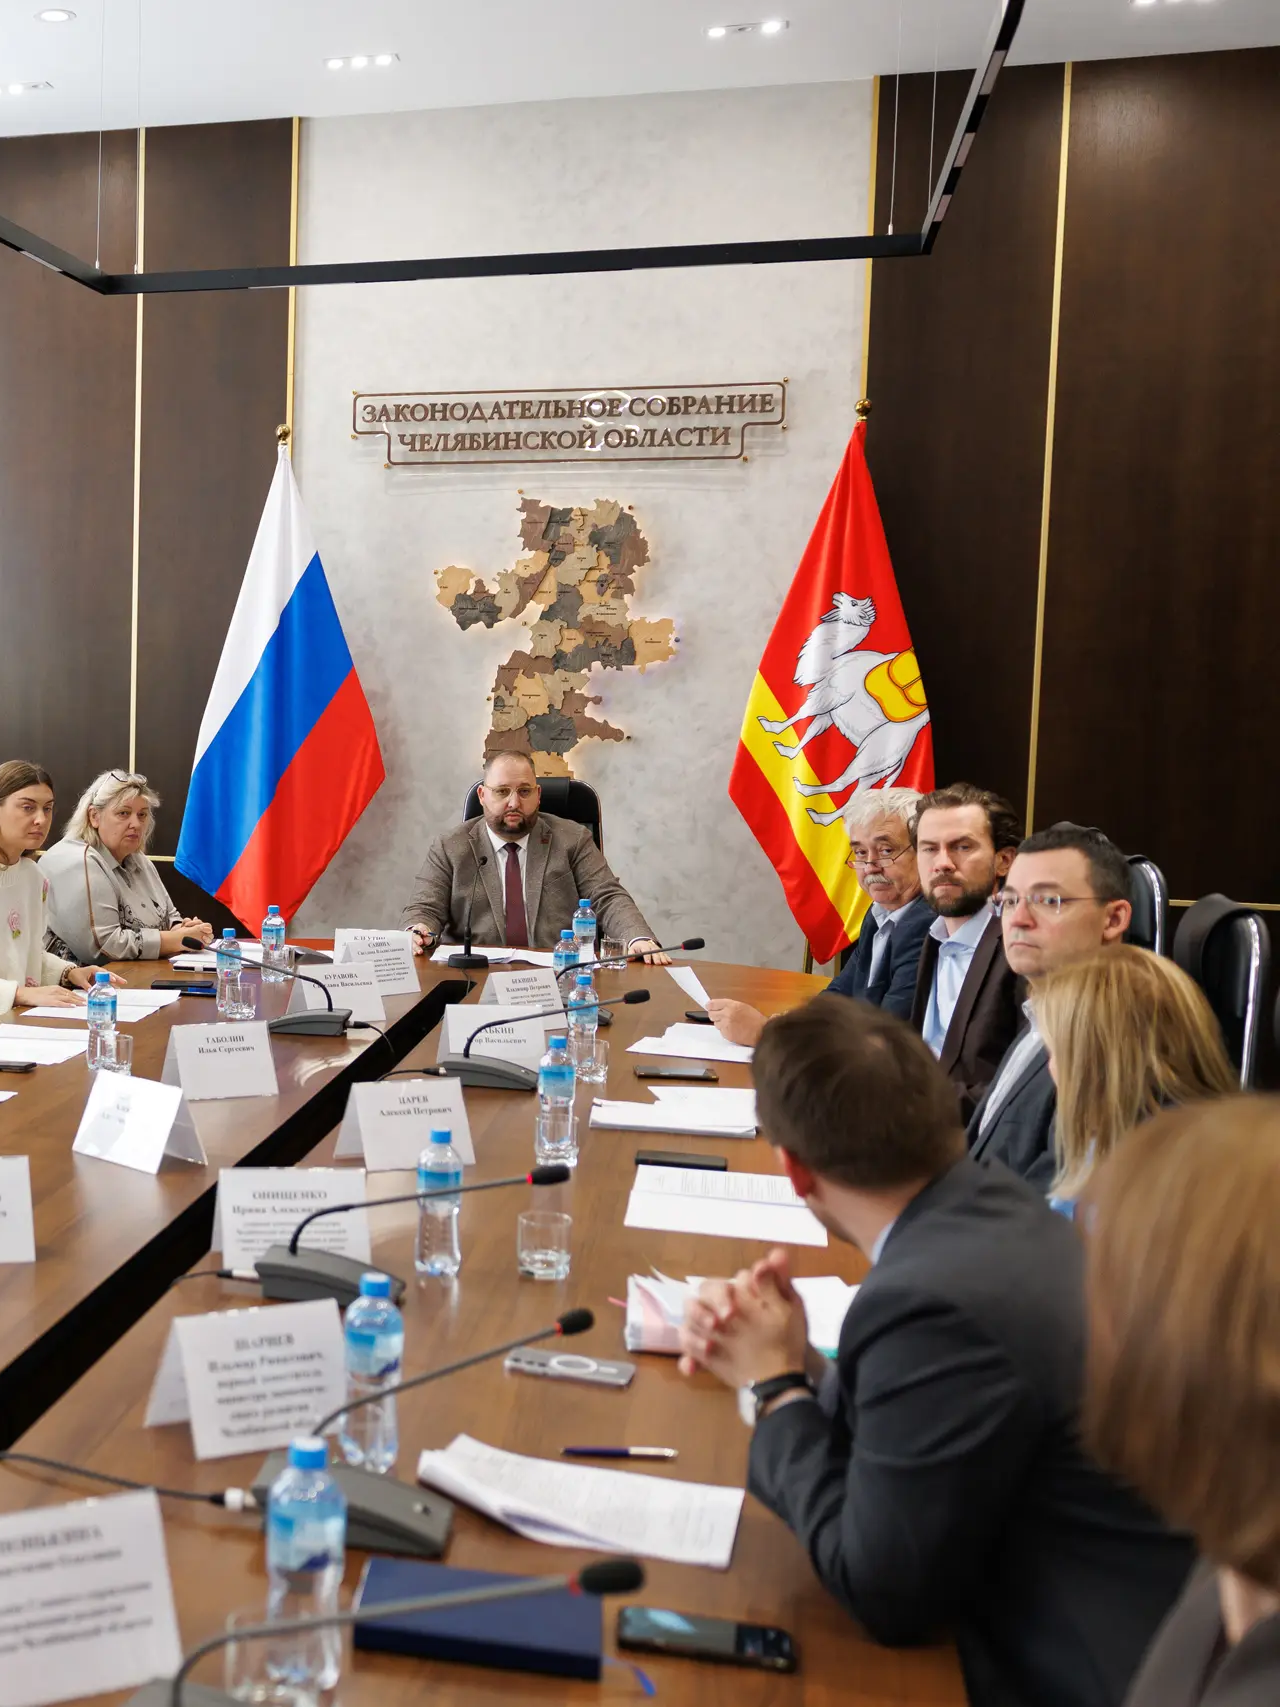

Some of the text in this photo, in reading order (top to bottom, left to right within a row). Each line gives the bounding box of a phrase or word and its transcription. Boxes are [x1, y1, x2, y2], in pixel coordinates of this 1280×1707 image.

[362, 393, 775, 423] ЗАКОНОДАТЕЛЬНОЕ СОБРАНИЕ
[397, 424, 732, 453] ЧЕЛЯБИНСКОЙ ОБЛАСТИ
[340, 980, 373, 988] Васильевна
[485, 1036, 527, 1044] Васильевич
[218, 1045, 255, 1055] Сергеевич
[379, 1107, 452, 1117] Алексей Петрович
[252, 1190, 328, 1201] ОНИЩЕНКО
